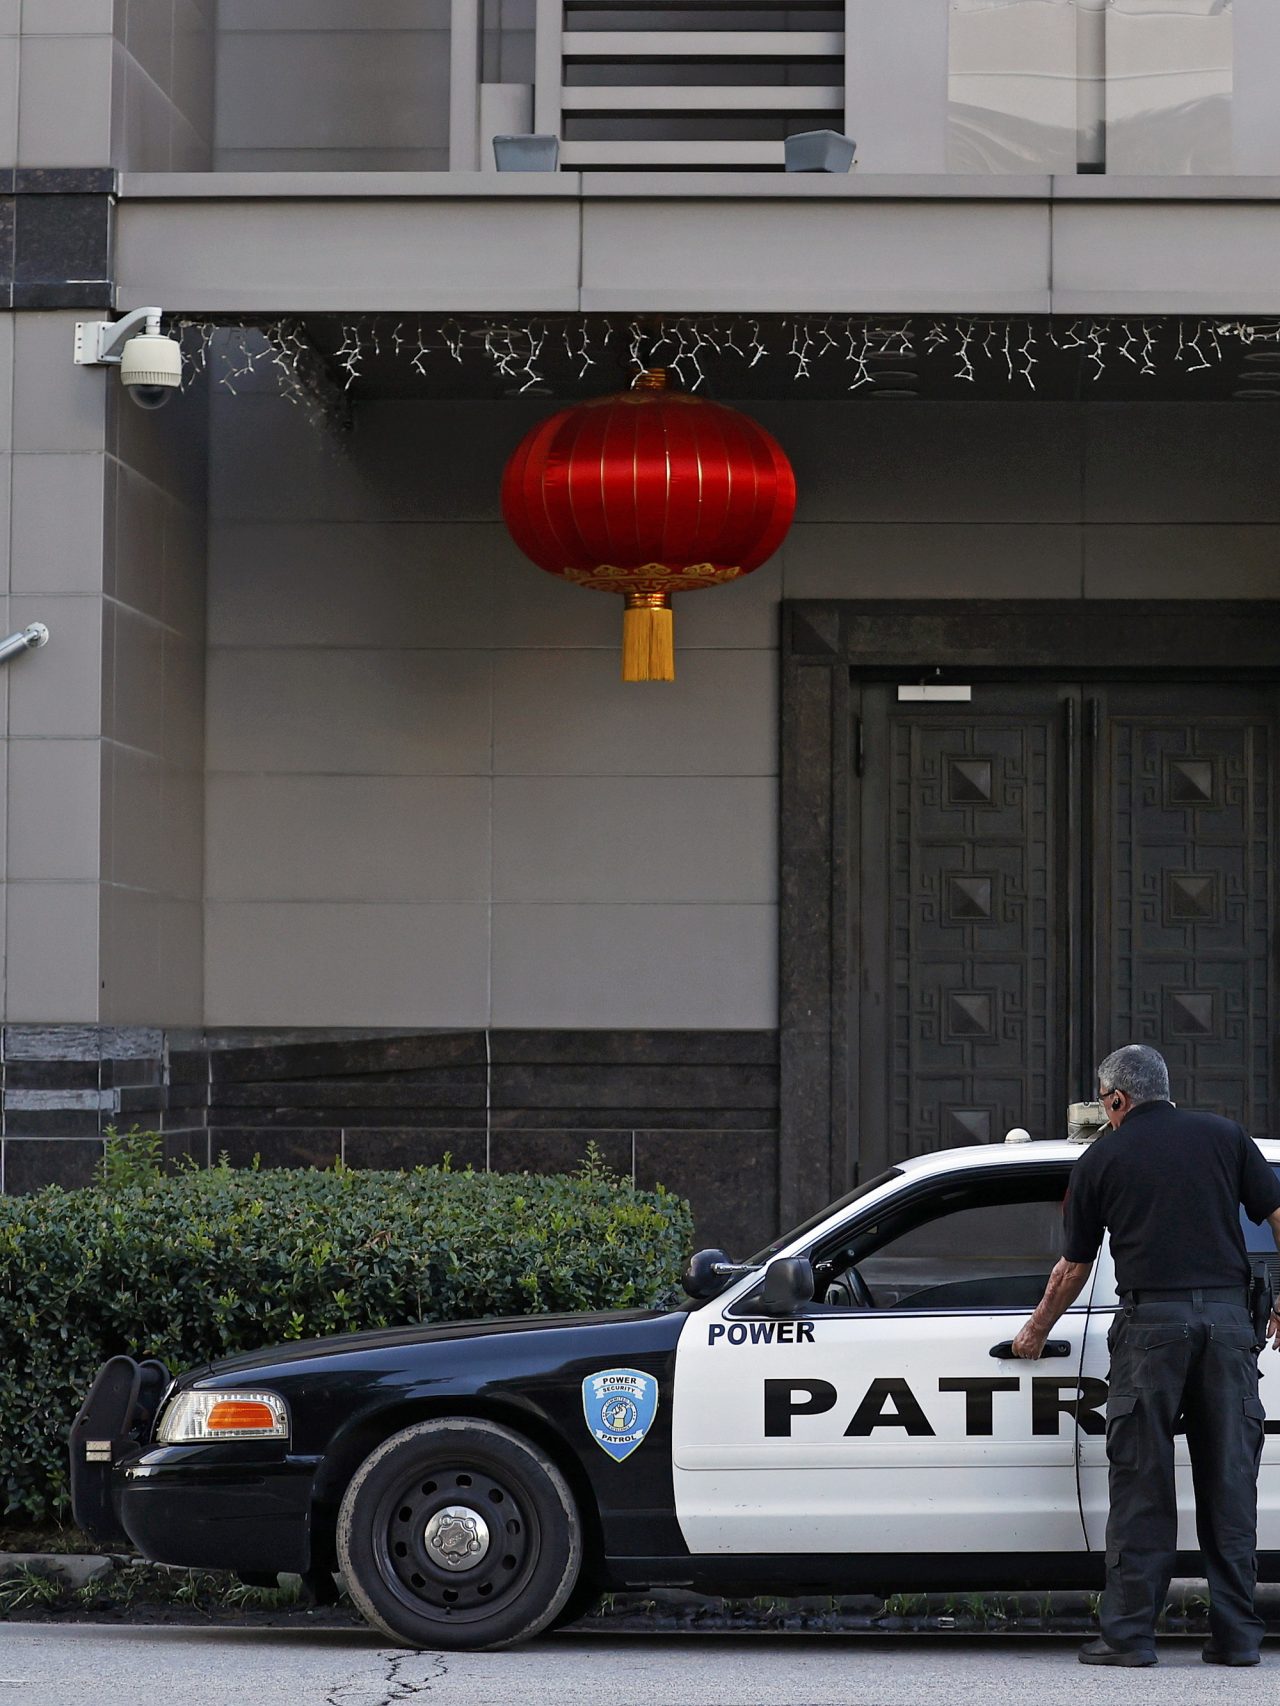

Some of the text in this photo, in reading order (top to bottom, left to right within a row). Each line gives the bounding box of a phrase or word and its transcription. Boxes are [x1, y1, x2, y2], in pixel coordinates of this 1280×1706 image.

[708, 1321, 816, 1346] POWER
[602, 1376, 637, 1385] POWER
[602, 1385, 635, 1393] SECURITY
[601, 1433, 637, 1443] PATROL
